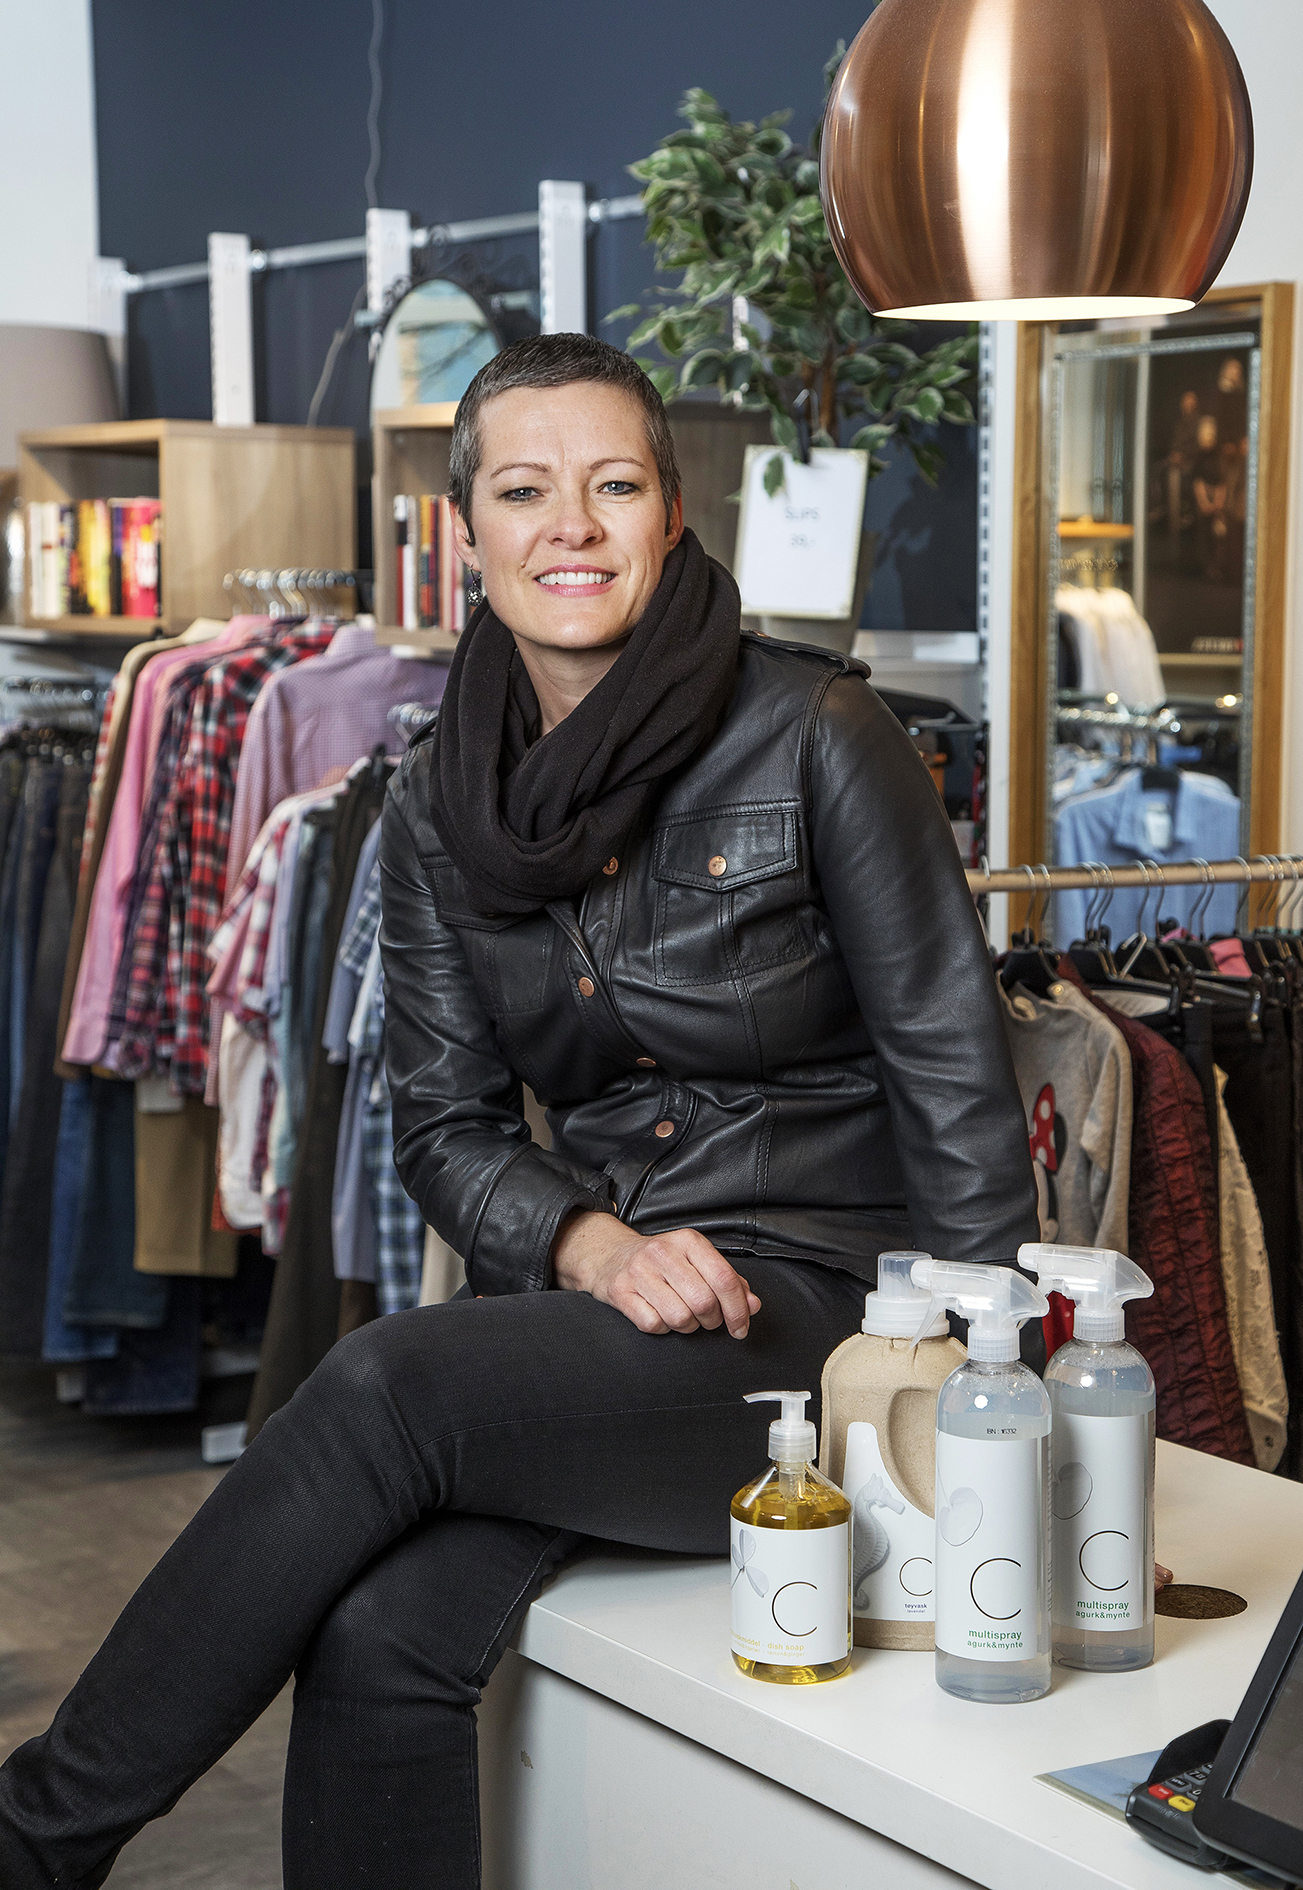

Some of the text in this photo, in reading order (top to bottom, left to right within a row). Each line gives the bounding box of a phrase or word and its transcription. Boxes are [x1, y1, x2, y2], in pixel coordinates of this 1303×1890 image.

[1078, 1530, 1130, 1592] C
[899, 1556, 933, 1597] C
[969, 1557, 1022, 1621] C
[771, 1581, 818, 1637] C
[1077, 1600, 1130, 1611] multispray
[1075, 1610, 1131, 1620] agurk&mynte
[968, 1630, 1022, 1641] multispray
[785, 1644, 805, 1652] soap
[967, 1640, 1023, 1650] agurk&mynte
